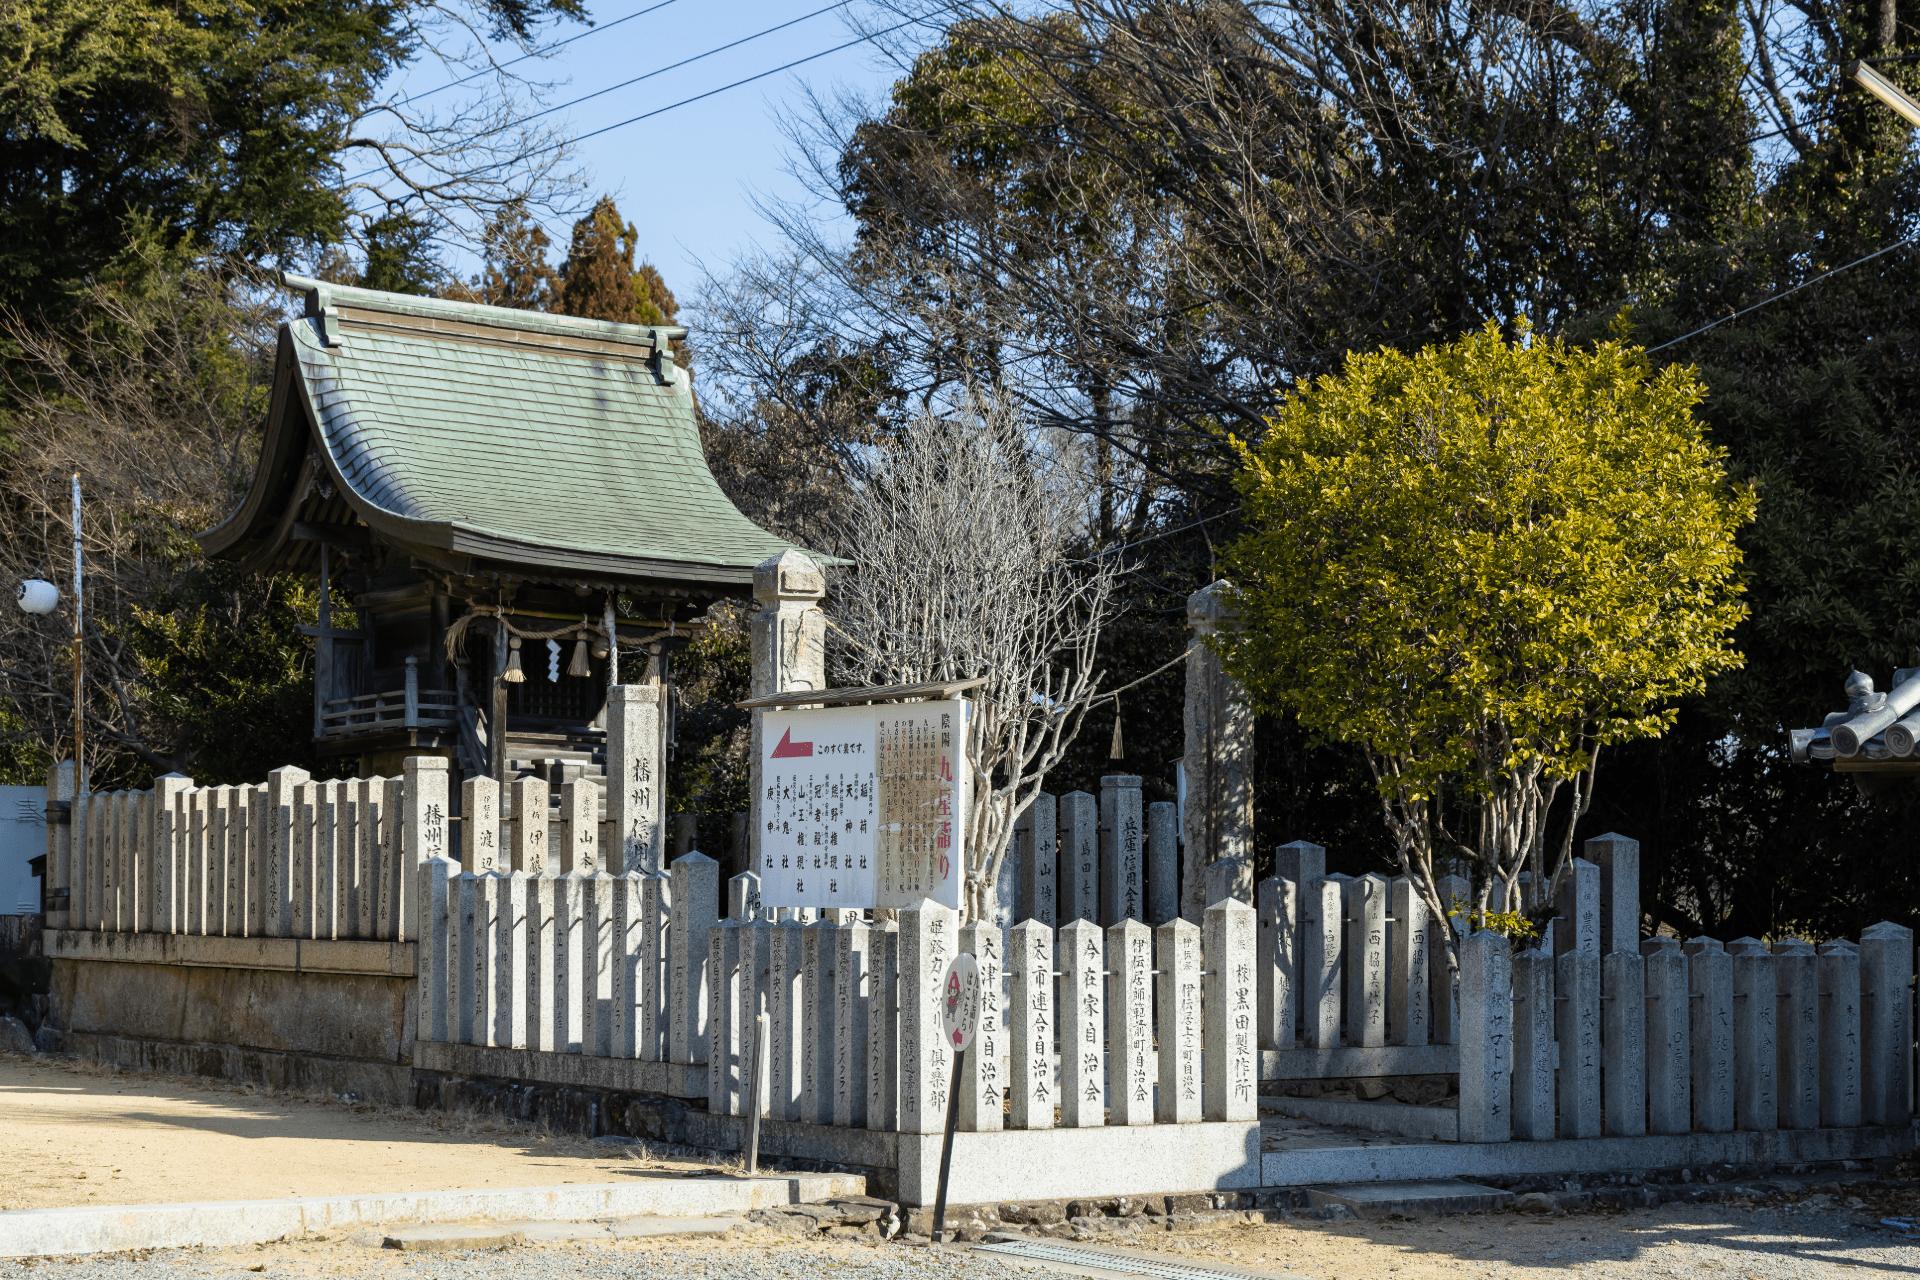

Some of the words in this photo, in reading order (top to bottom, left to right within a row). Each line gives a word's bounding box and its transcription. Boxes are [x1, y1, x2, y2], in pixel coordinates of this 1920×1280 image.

[480, 829, 495, 871] 渡辺
[579, 829, 593, 869] 山本
[781, 785, 790, 869] 大鬼社
[844, 784, 854, 869] 天神社
[1122, 816, 1138, 919] 兵庫信用金庫
[980, 937, 1000, 1106] 大津校区自治会
[1031, 938, 1050, 1104] 太市連合自治会
[1083, 939, 1101, 1102] 今在家自治会
